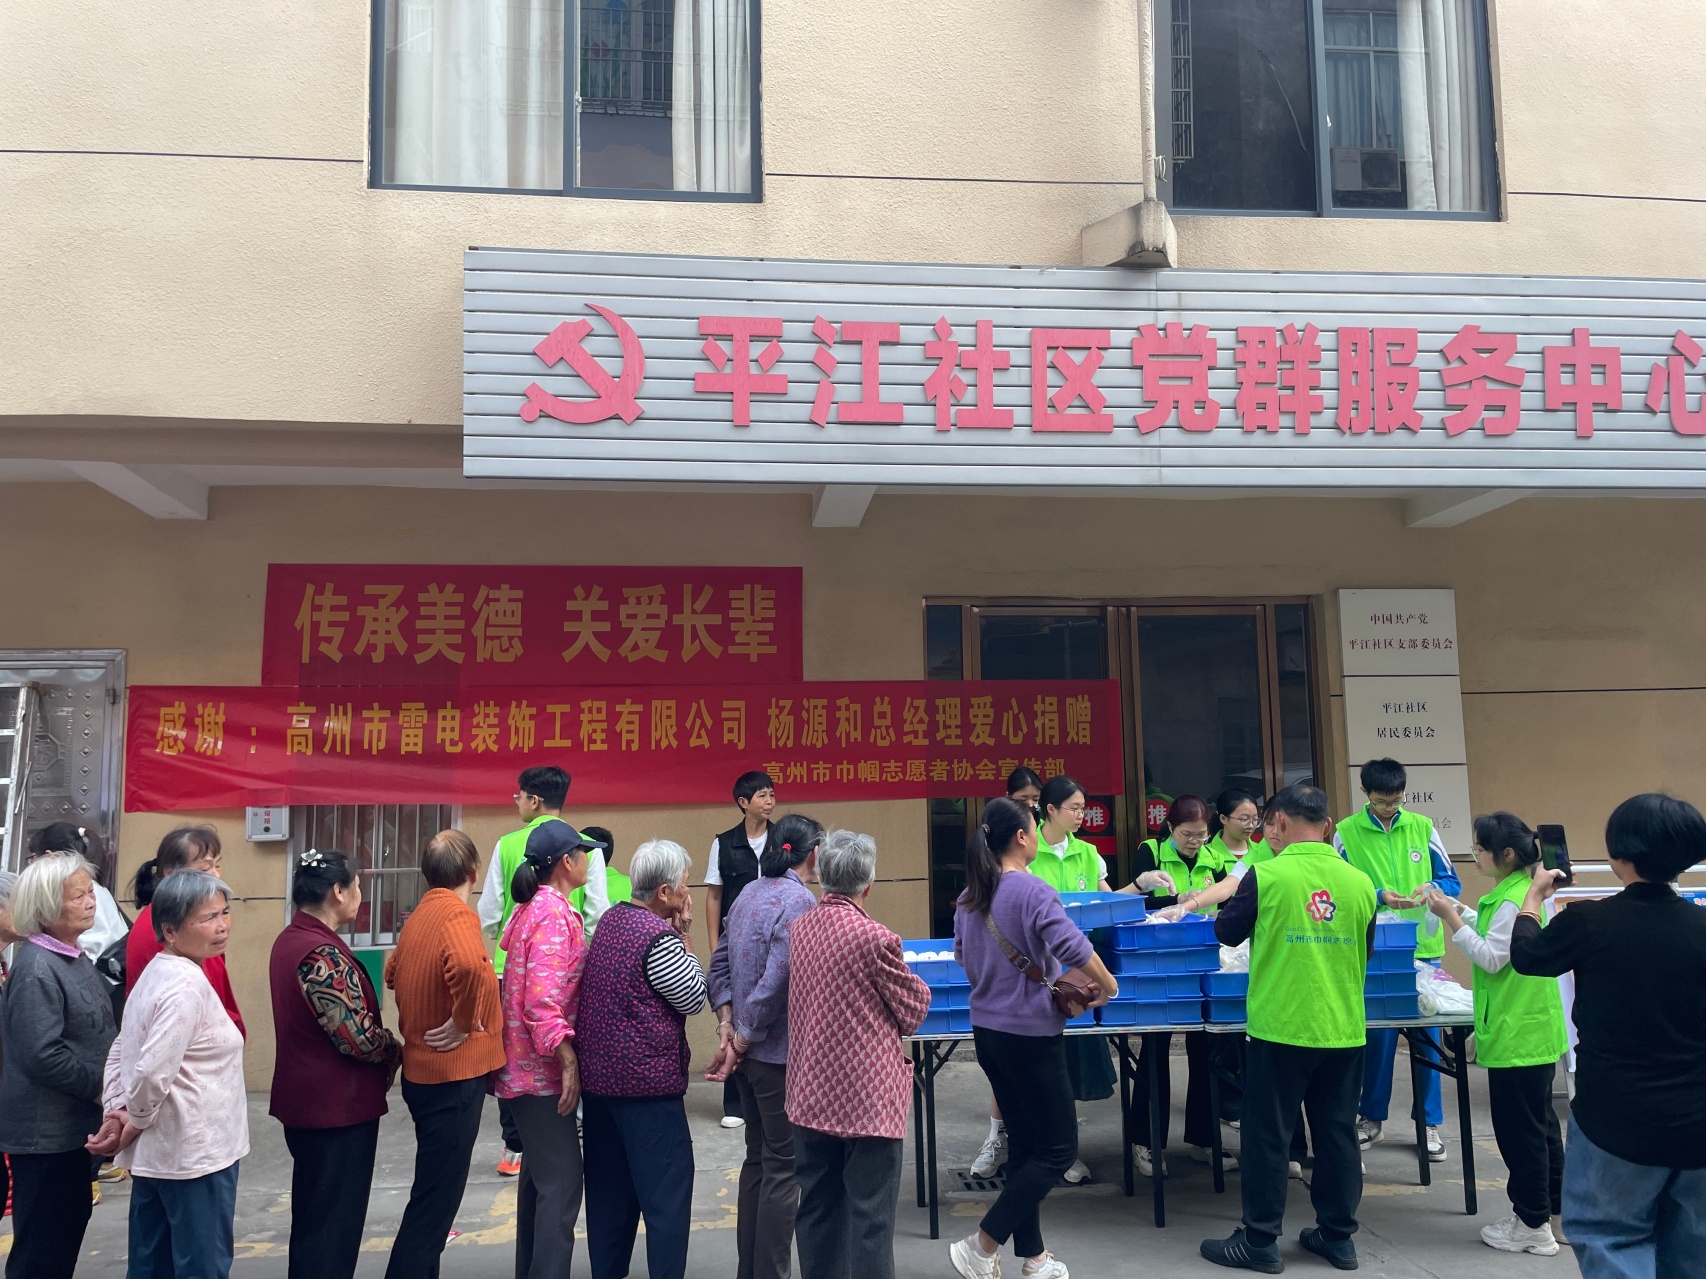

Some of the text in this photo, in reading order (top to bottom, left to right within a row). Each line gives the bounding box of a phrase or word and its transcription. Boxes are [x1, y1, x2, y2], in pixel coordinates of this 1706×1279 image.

[693, 313, 1706, 438] 平江社区党群服务中心
[294, 582, 778, 664] 传承美德 关爱长辈
[1370, 613, 1429, 625] 中国共产党
[1349, 637, 1453, 650] 平江社区支部委员会
[1382, 701, 1428, 714] 平江社区
[767, 694, 1092, 749] 杨源和总经理爱心捐赠
[1377, 726, 1435, 739] 居民委员会
[762, 757, 1066, 785] 高州市巾帼志愿者协会宣传部
[1085, 806, 1105, 827] 推
[1148, 804, 1167, 825] 推
